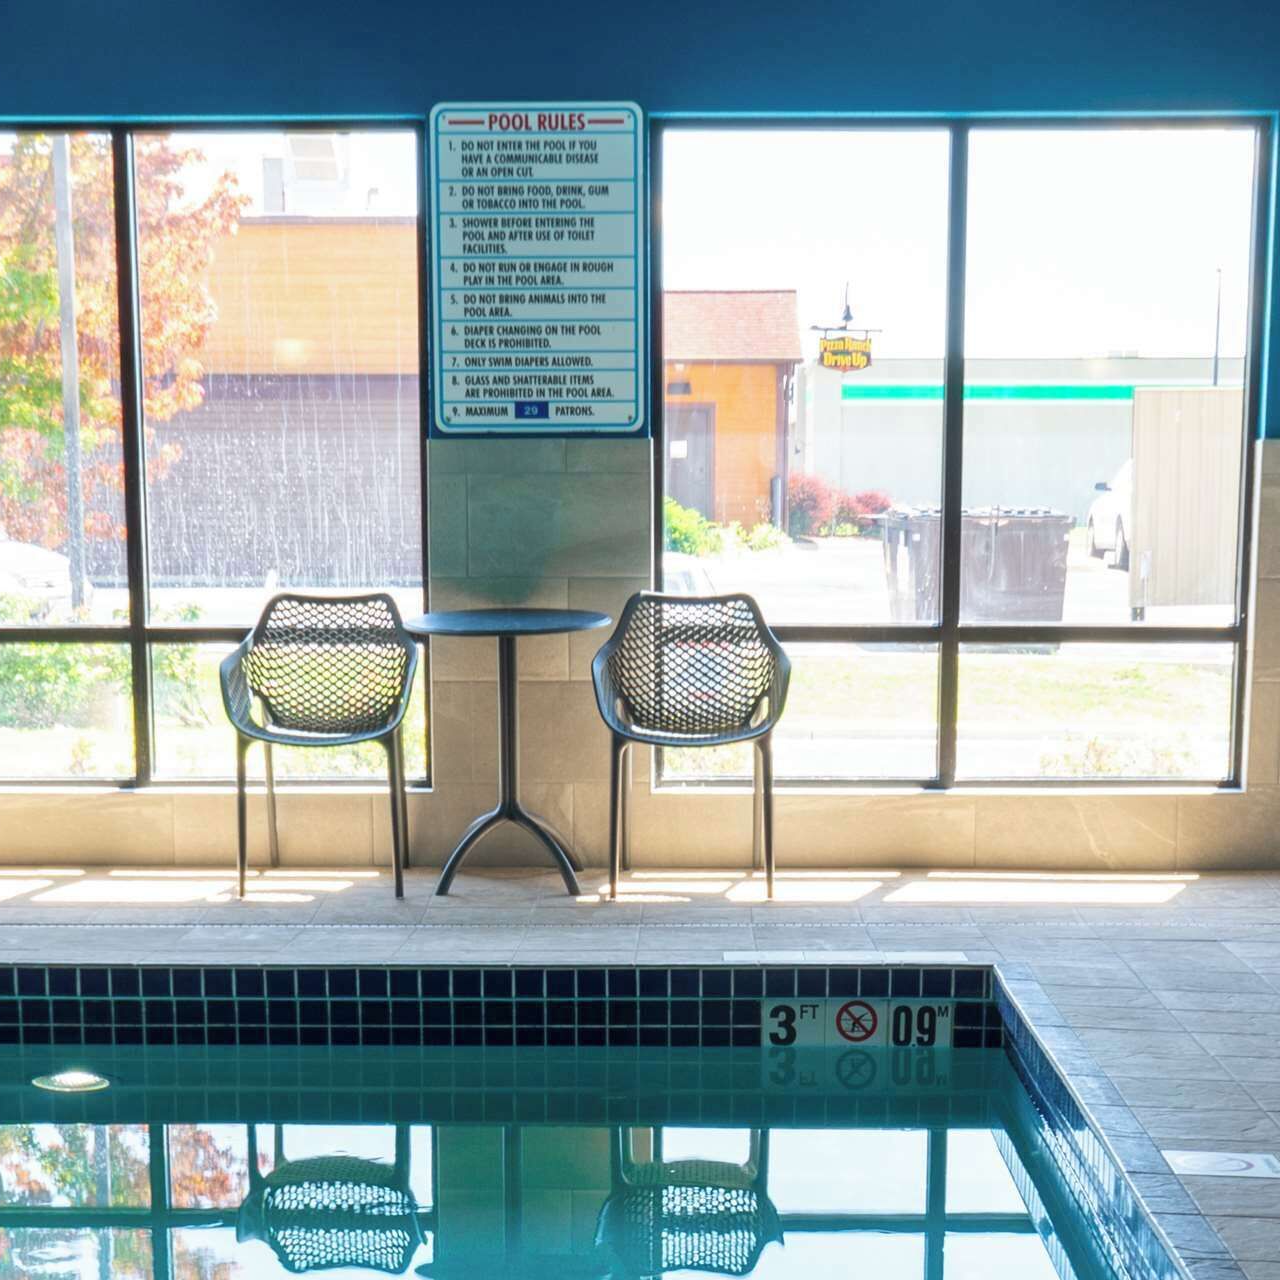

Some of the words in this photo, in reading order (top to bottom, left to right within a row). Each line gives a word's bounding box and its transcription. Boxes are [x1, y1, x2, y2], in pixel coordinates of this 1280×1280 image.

[489, 114, 532, 132] POOL
[538, 114, 585, 132] RULES
[461, 141, 474, 151] DO
[477, 141, 493, 151] NOT
[497, 141, 522, 151] ENTER
[526, 140, 540, 151] THE
[544, 140, 566, 150] POOL
[569, 141, 575, 150] IF
[579, 140, 596, 150] YOU
[462, 154, 483, 164] HAVE
[486, 154, 491, 164] A
[494, 153, 562, 164] COMMUNICABLE
[566, 153, 598, 164] DISEASE
[462, 167, 473, 178] OR
[476, 167, 488, 177] AN
[491, 167, 513, 177] OPEN
[462, 186, 475, 196] DO
[478, 186, 494, 196] NOT
[498, 186, 524, 196] BRING
[527, 185, 553, 198] FOOD,
[556, 186, 585, 198] DRINK,
[588, 185, 608, 196] GUM
[462, 199, 474, 209] OR
[477, 198, 516, 209] TOBACCO
[519, 198, 539, 209] INTO
[542, 198, 556, 209] THE
[560, 198, 586, 209] POOL.
[462, 218, 498, 228] SHOWER
[501, 217, 531, 228] BEFORE
[535, 217, 576, 228] ENTERING
[580, 217, 594, 227] THE
[463, 231, 485, 241] POOL
[488, 231, 506, 241] AND
[509, 230, 533, 241] AFTER
[536, 230, 550, 241] USE
[554, 230, 564, 240] OF
[568, 230, 594, 240] TOILET
[463, 243, 508, 254] FACILITIES.
[463, 263, 476, 273] DO
[479, 262, 495, 273] NOT
[499, 262, 516, 272] RUN
[519, 262, 531, 272] OR
[534, 262, 567, 272] ENGAGE
[571, 262, 579, 272] IN
[583, 262, 613, 272] ROUGH
[464, 276, 482, 286] PLAY
[485, 275, 494, 285] IN
[498, 275, 512, 286] THE
[515, 275, 538, 286] POOL
[541, 275, 564, 285] AREA.
[464, 294, 476, 304] DO
[479, 294, 496, 304] NOT
[499, 294, 525, 304] BRING
[528, 294, 565, 304] ANIMALS
[568, 294, 588, 304] INTO
[591, 294, 605, 304] THE
[464, 307, 486, 317] POOL
[489, 307, 513, 317] AREA.
[464, 326, 494, 336] DIAPER
[497, 325, 542, 336] CHANGING
[545, 325, 558, 335] ON
[561, 325, 575, 335] THE
[579, 325, 600, 335] POOL
[464, 338, 486, 349] DECK
[489, 338, 496, 348] IS
[499, 338, 552, 348] PROHIBITED.
[465, 357, 486, 367] ONLY
[488, 357, 512, 367] SWIM
[515, 357, 549, 367] DIAPERS
[552, 356, 593, 367] ALLOWED.
[823, 352, 851, 367] Drive
[852, 352, 867, 368] Up
[465, 376, 490, 385] GLASS
[492, 376, 510, 385] AND
[513, 375, 566, 385] SHATTERABLE
[570, 375, 594, 385] ITEMS
[465, 388, 480, 398] ARE
[483, 388, 533, 398] PROHIBITED
[536, 388, 545, 397] IN
[548, 388, 563, 398] THE
[566, 388, 588, 398] POOL
[591, 388, 613, 397] AREA.
[466, 406, 508, 416] MAXIMUM
[556, 406, 594, 416] PATRONS.
